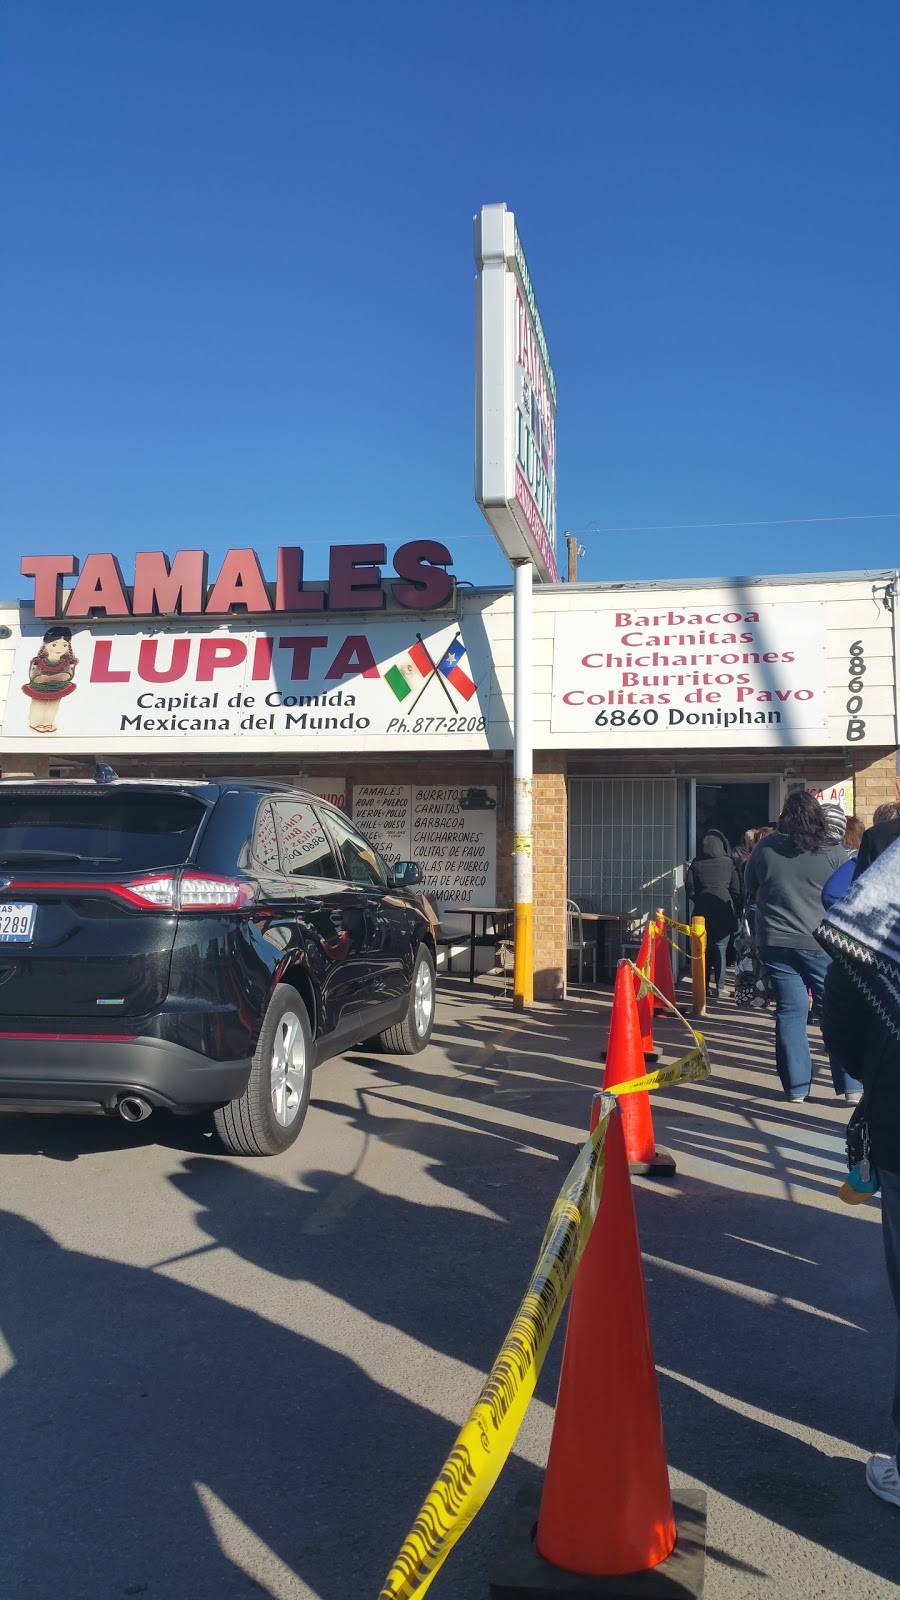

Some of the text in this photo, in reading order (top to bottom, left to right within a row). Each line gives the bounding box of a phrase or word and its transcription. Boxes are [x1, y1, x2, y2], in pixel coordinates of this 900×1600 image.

[20, 540, 454, 618] TAMALES
[614, 610, 761, 628] Barbacoa
[620, 631, 753, 648] Carnitas
[90, 634, 381, 684] LUPITA
[581, 649, 796, 669] Chicharrones
[621, 670, 751, 687] Burritos
[136, 690, 356, 712] Capital de Comida
[562, 685, 814, 706] Colitas de Pavo
[120, 713, 370, 732] Mexicana del Mundo
[594, 707, 782, 728] 6860 Doniphan
[358, 786, 404, 796] TAMALES
[415, 789, 465, 801] BURRITOS
[355, 798, 375, 807] ROJO
[382, 798, 408, 807] PUERCO
[356, 809, 382, 818] VERDE
[385, 809, 407, 818] POLLO
[414, 803, 460, 815] CARNITAS
[355, 820, 377, 829] CHILE
[383, 820, 406, 829] QUESO
[414, 817, 465, 829] BARBACOA
[413, 831, 484, 843] CHICHARRONES
[413, 845, 486, 857] COLITAS DE PAVO
[444, 860, 457, 872] DE
[457, 860, 490, 872] PUERCO
[418, 875, 487, 887] ATA DE PUERCO
[0, 905, 13, 913] AS
